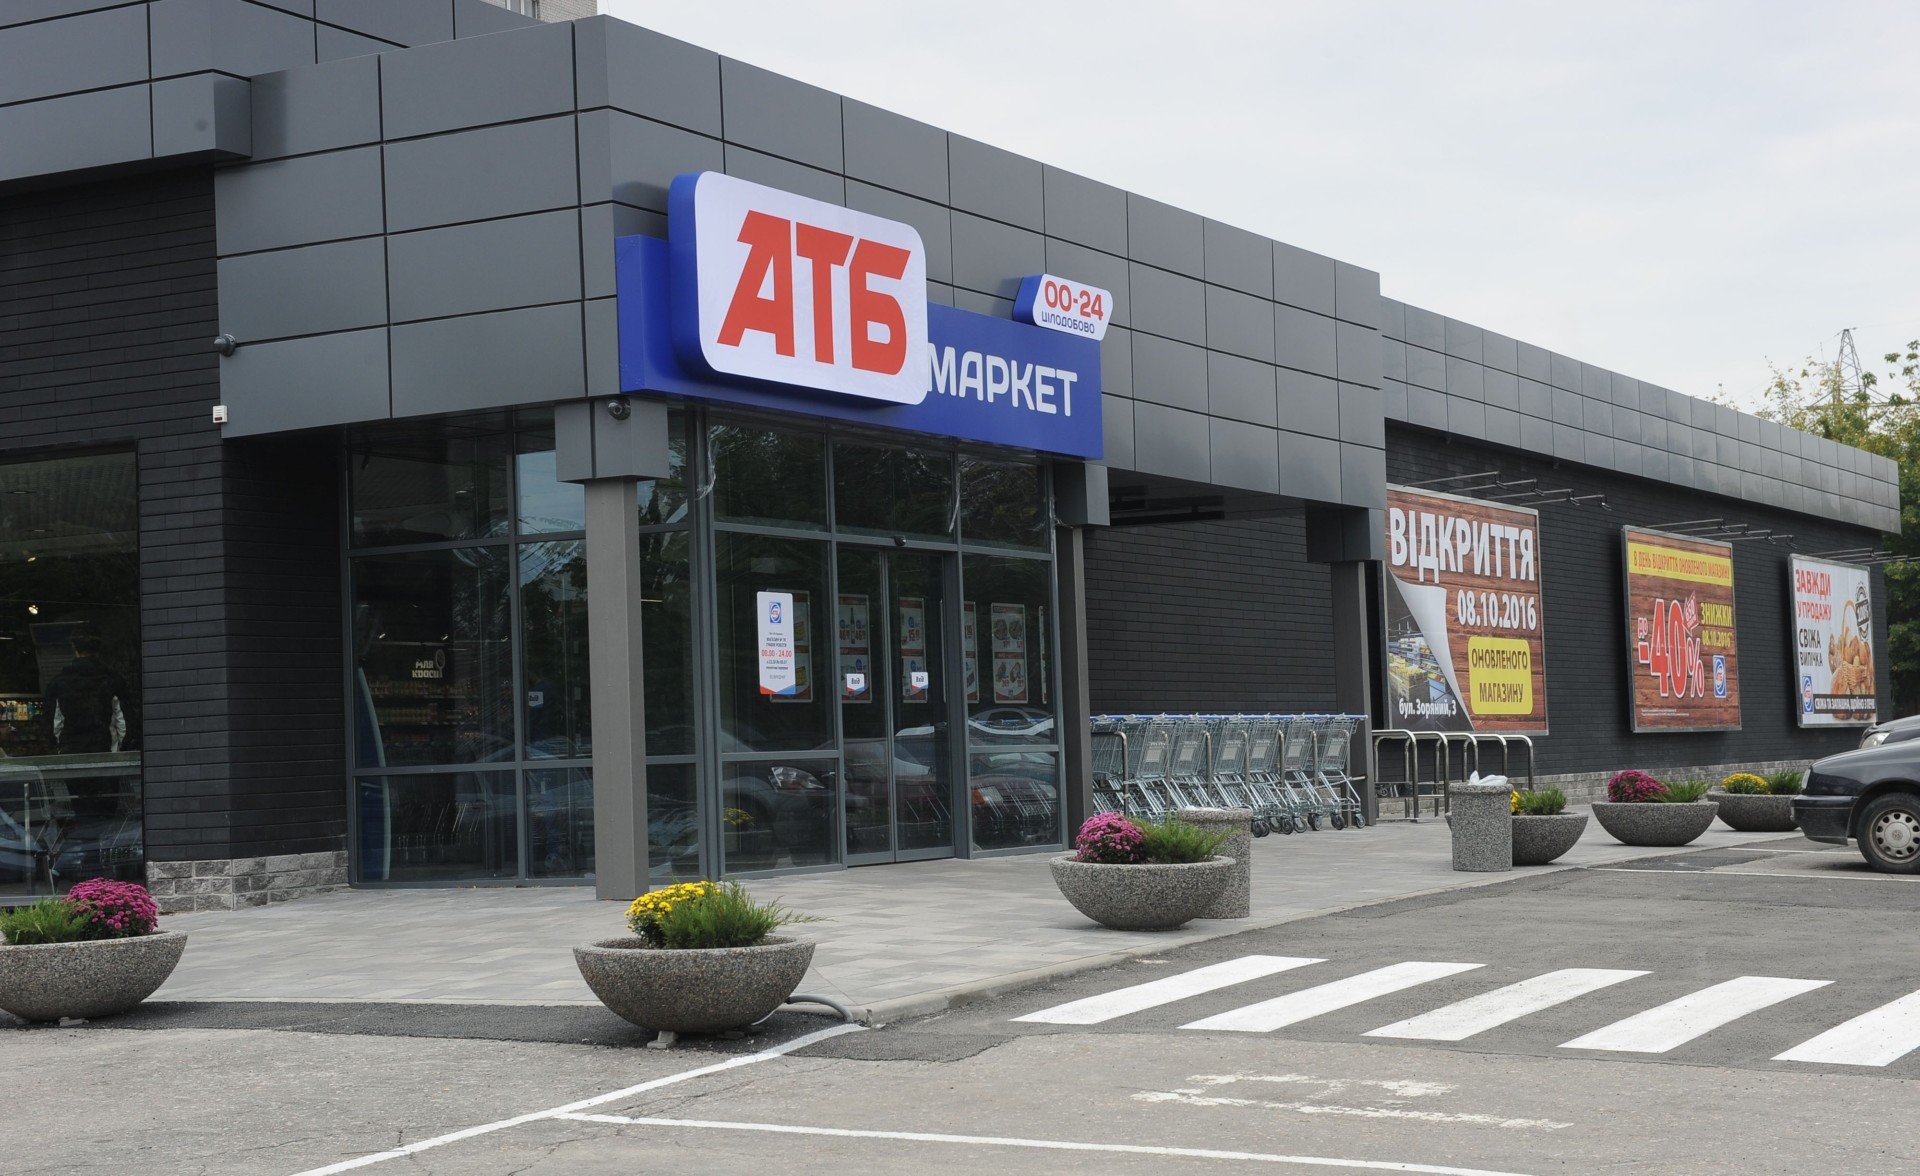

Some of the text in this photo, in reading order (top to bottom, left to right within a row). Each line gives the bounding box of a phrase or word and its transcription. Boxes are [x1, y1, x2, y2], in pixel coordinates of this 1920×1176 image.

[717, 209, 911, 376] АТБ
[1044, 280, 1104, 321] 00-24
[1041, 310, 1095, 334] ЦІЛОДОБОВО
[926, 342, 1078, 417] МАРКЕТ
[1389, 507, 1535, 584] ВІДКРИТТЯ
[1795, 568, 1832, 601] ЗАВЖДИ
[1457, 588, 1537, 631] 08.10.2016
[1802, 601, 1832, 623] ПРОДАЖУ
[1798, 627, 1821, 649] СВІЖА
[1471, 647, 1528, 671] ОНОВЛЕНОГО
[1479, 682, 1524, 704] МАГАЗИНУ
[1399, 698, 1457, 719] бул. Зоряний, 3
